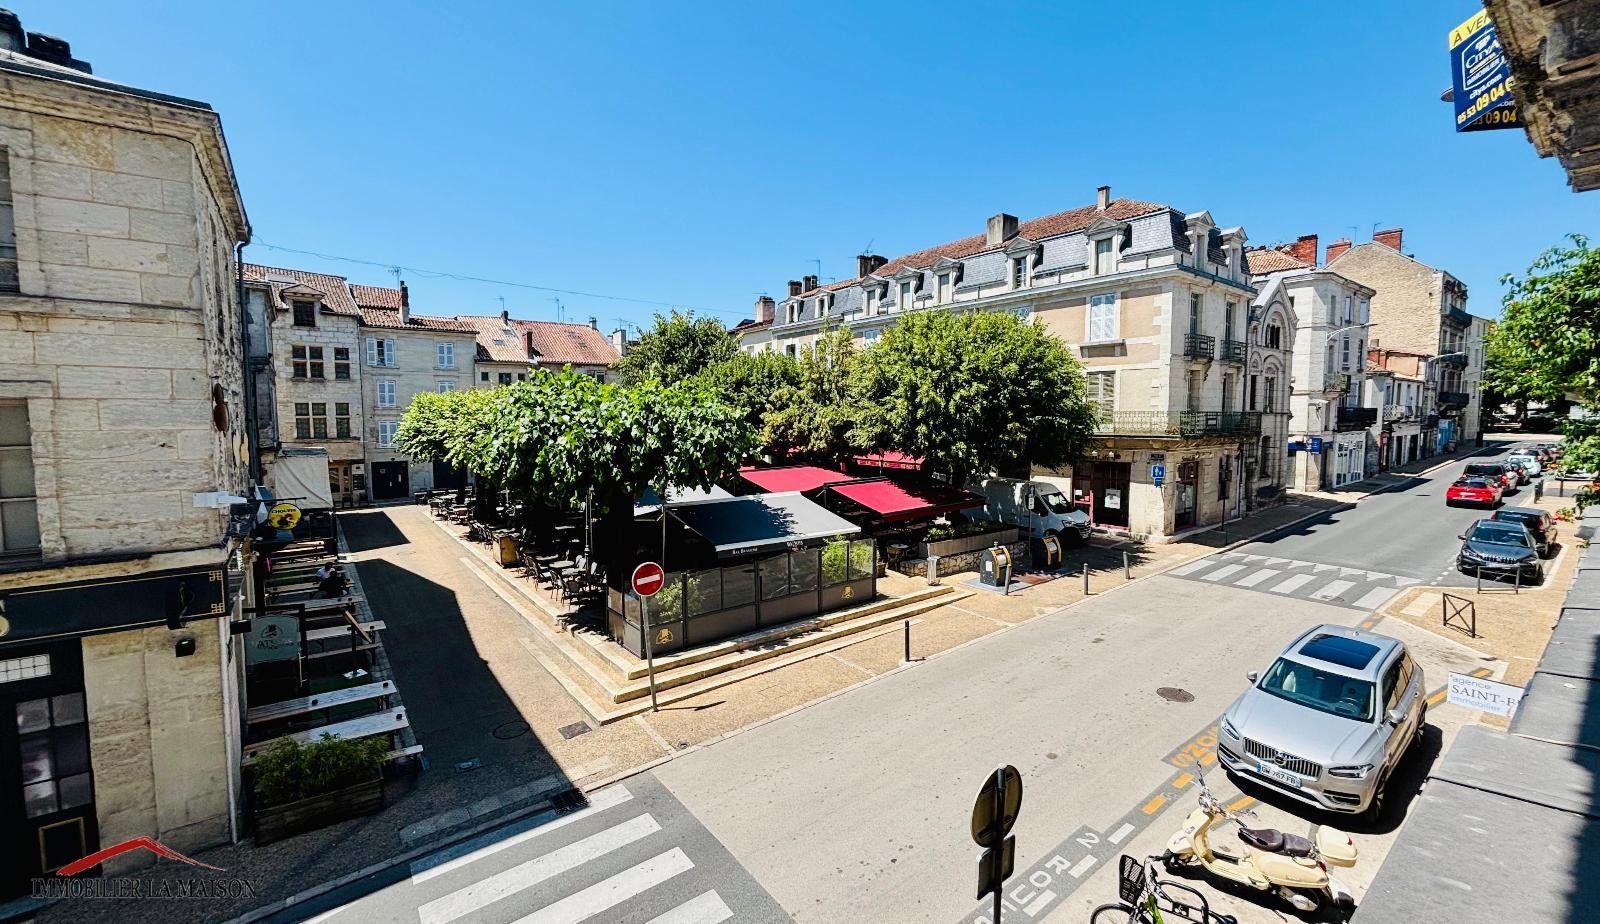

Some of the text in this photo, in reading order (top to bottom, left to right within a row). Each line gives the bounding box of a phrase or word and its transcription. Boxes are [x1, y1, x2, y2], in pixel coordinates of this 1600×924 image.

[1476, 93, 1490, 111] 09
[1490, 83, 1505, 101] 04
[1502, 110, 1517, 123] 04
[1452, 677, 1492, 690] agence
[1076, 832, 1099, 849] 2
